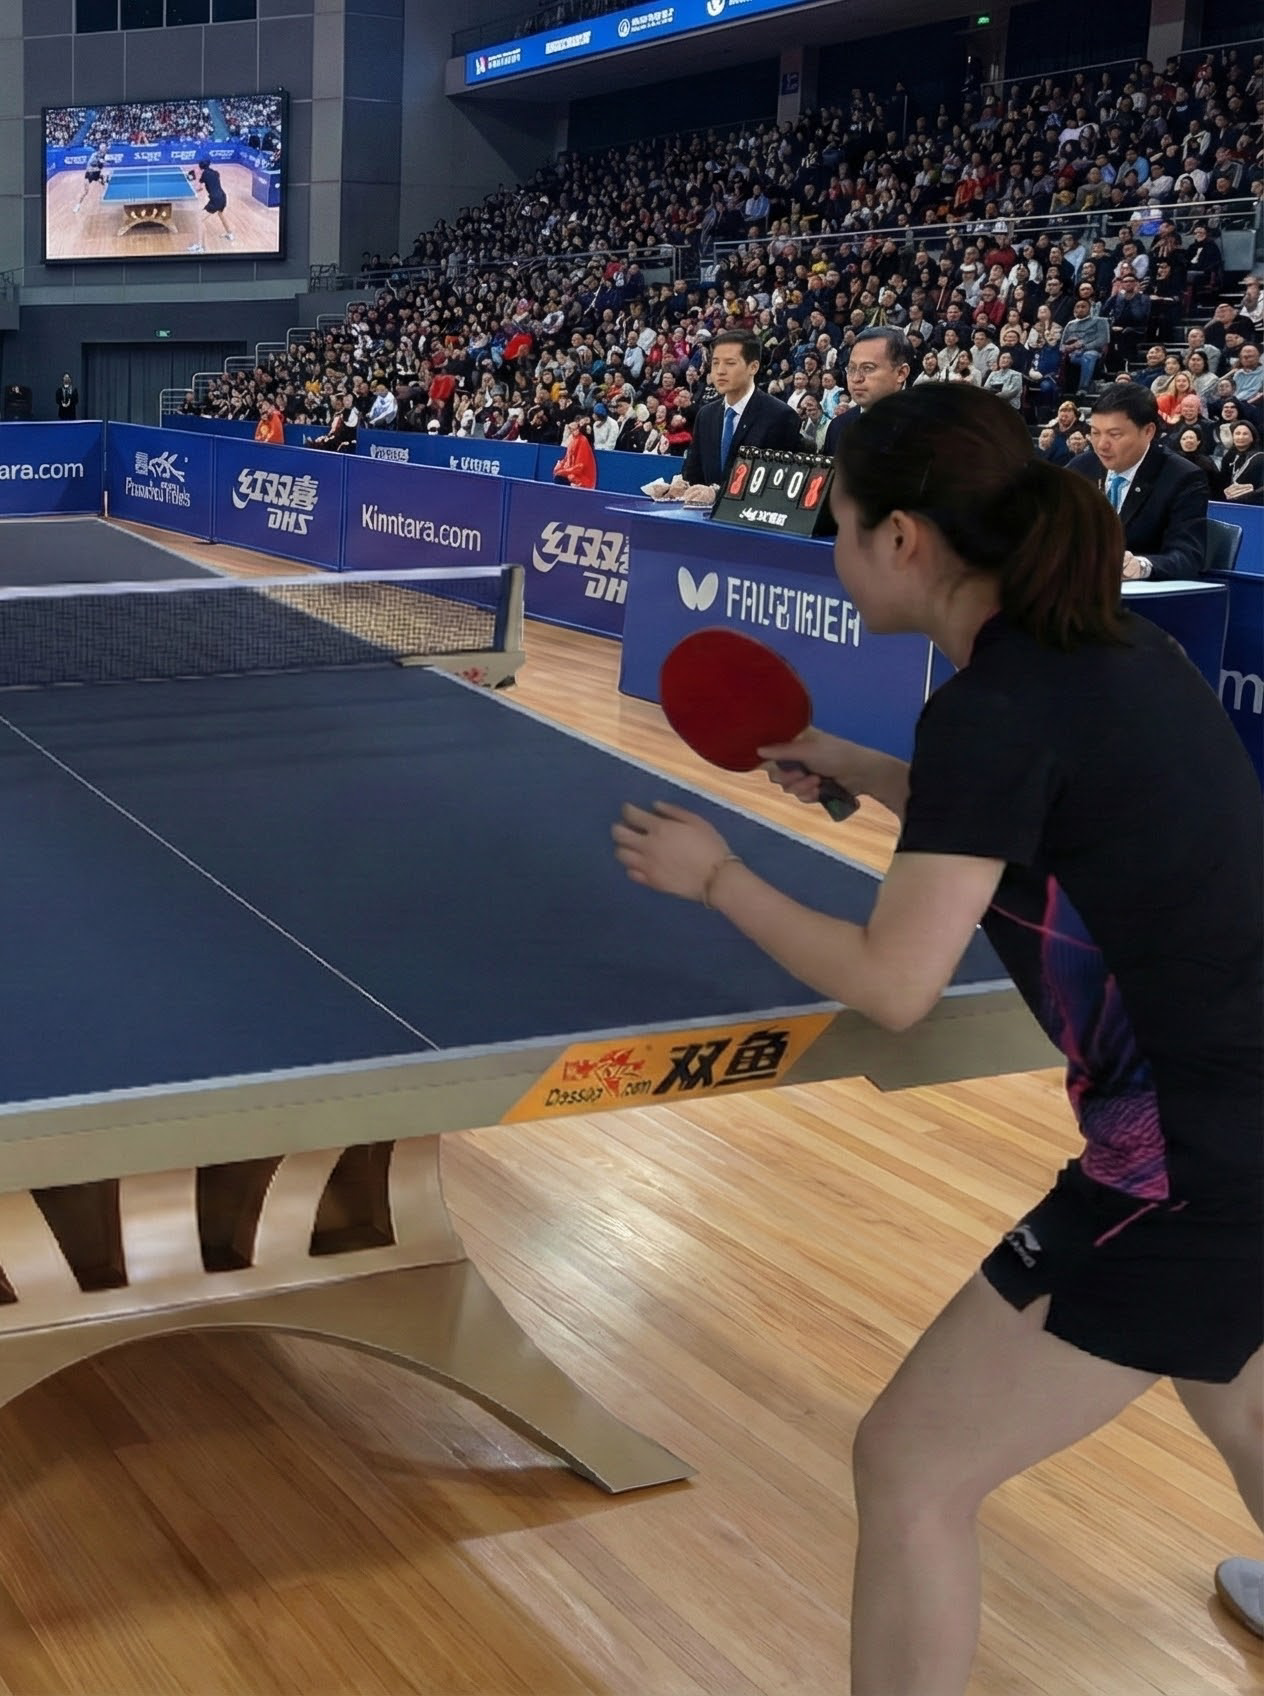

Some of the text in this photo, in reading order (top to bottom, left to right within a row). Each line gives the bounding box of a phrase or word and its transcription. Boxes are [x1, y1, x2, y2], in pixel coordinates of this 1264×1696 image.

[232, 468, 319, 509] 红双喜
[787, 471, 804, 499] 0
[267, 508, 314, 535] DHS
[583, 571, 629, 605] DH
[652, 1025, 791, 1096] 双鱼
